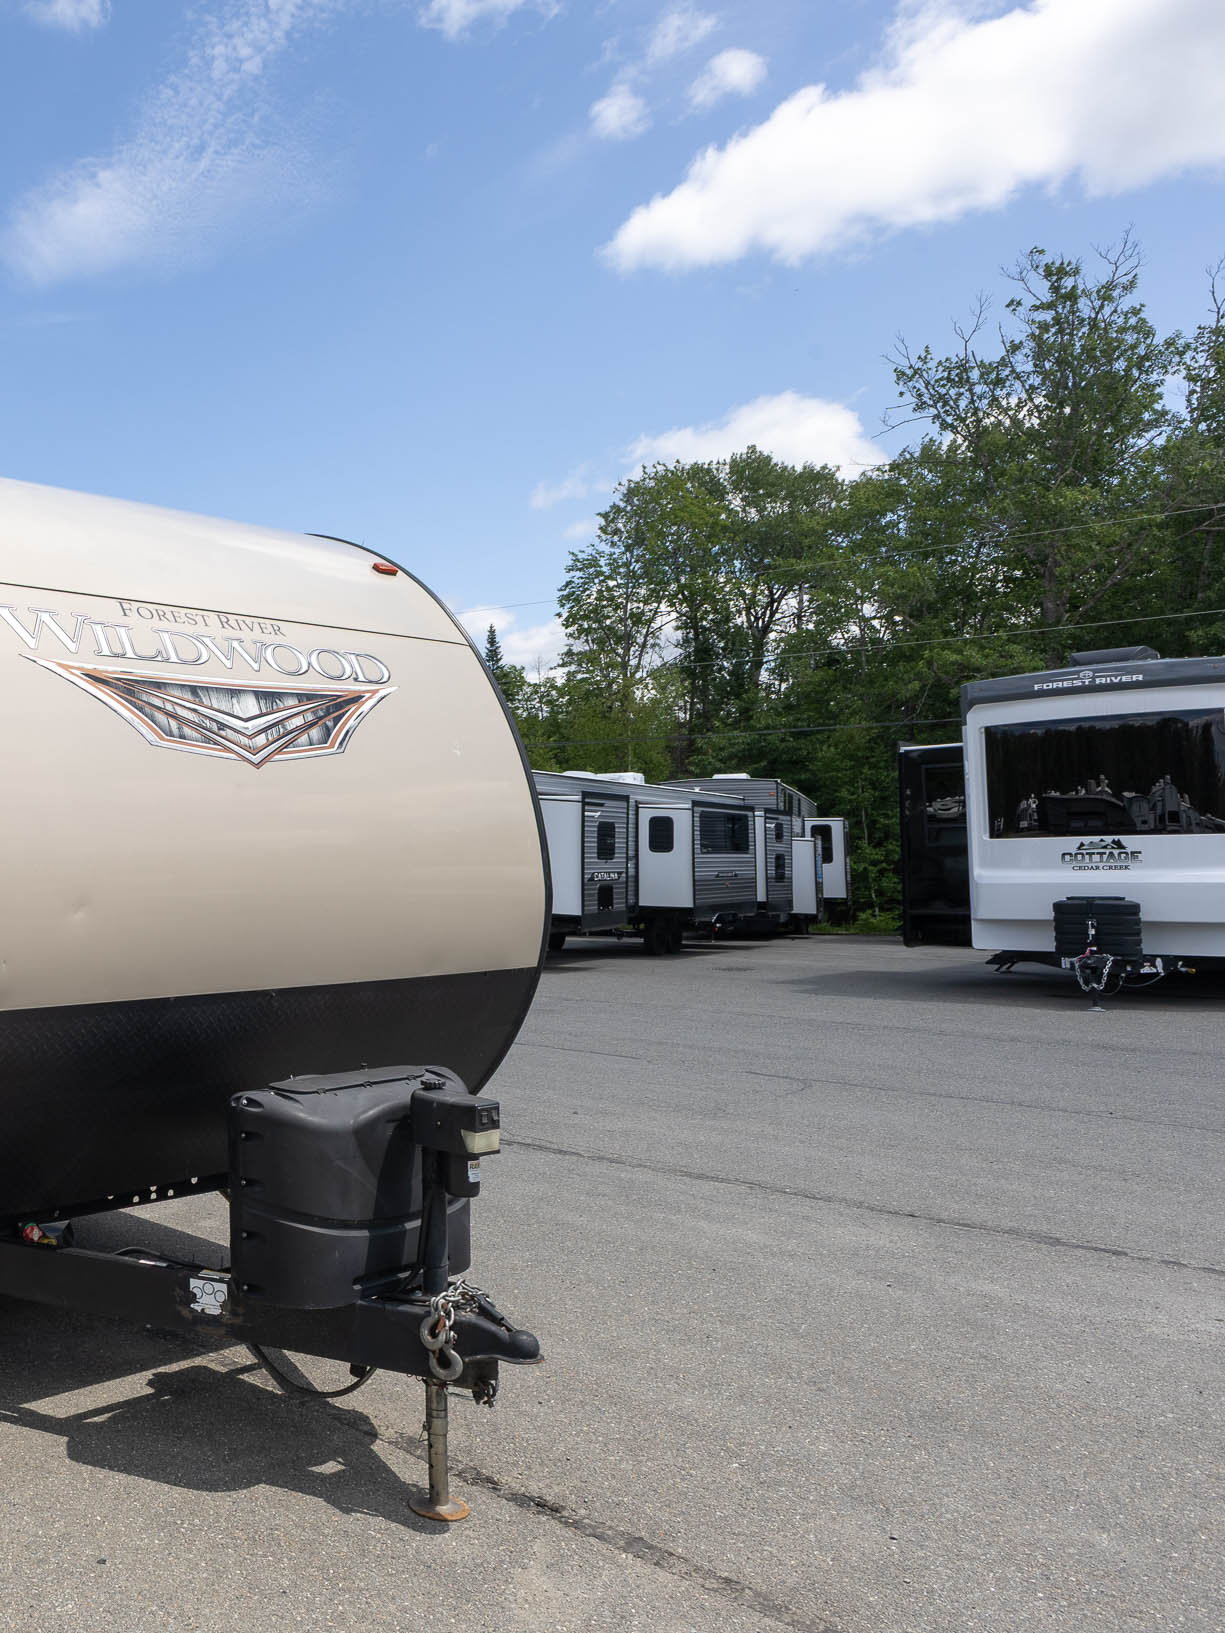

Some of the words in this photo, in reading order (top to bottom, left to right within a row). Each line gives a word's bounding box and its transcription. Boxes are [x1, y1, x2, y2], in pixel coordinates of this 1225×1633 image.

[117, 600, 211, 627] FOREST
[217, 613, 286, 637] RIVER
[1033, 678, 1093, 691] FOREST
[1095, 674, 1144, 685] RIVER
[1061, 850, 1143, 865] COTTAGE
[593, 872, 619, 881] CATALINA
